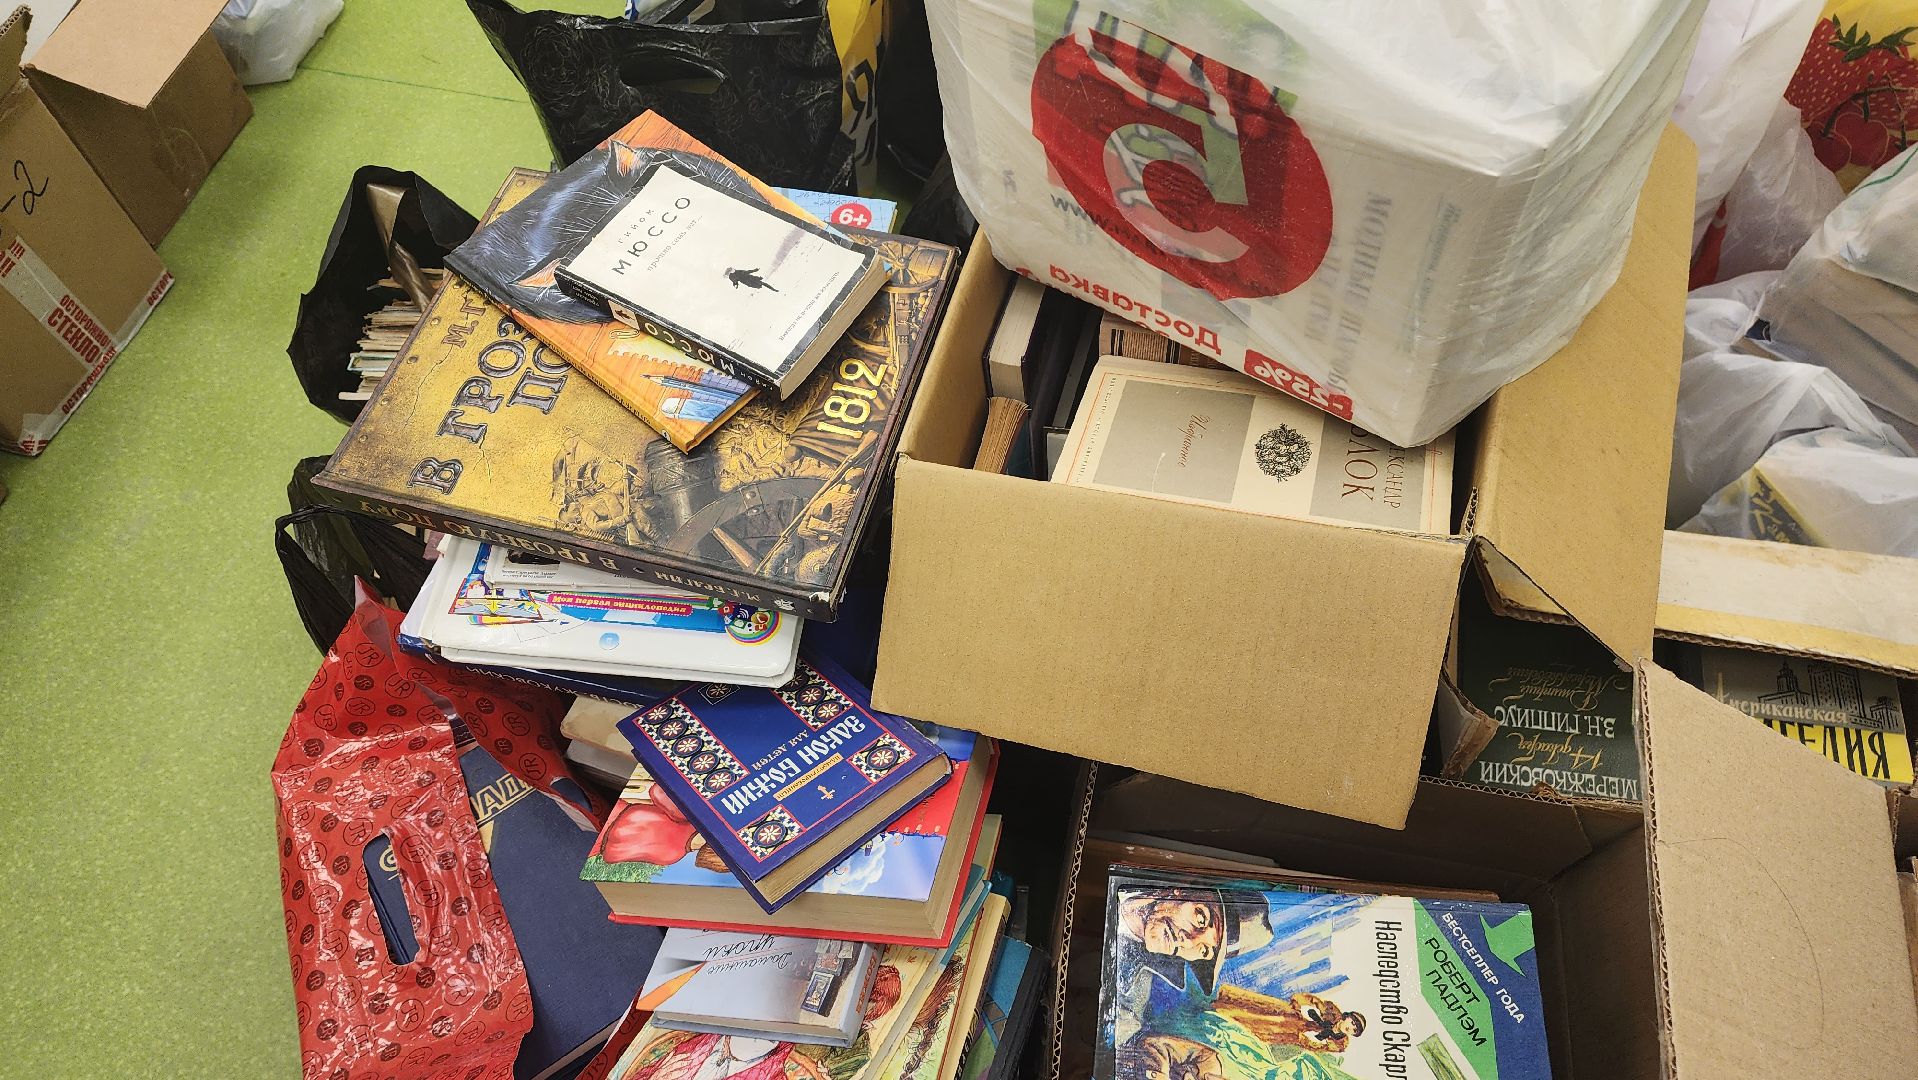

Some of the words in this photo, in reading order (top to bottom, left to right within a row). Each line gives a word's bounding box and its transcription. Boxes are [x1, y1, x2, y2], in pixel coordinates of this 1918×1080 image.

[611, 197, 691, 275] МЮССО
[838, 208, 868, 226] 6+
[644, 321, 736, 376] МЮССО
[816, 357, 889, 439] 1812
[406, 455, 464, 496] В
[359, 500, 439, 529] ПОРУ
[443, 520, 592, 565] ГРОЗНУЮ
[598, 555, 620, 571] В
[575, 597, 611, 608] первая
[613, 600, 687, 613] энциклопедия
[796, 714, 866, 766] ЗАКОН
[1494, 704, 1581, 734] ГИППИУС
[720, 757, 802, 815] БОЖИЙ
[1479, 760, 1638, 800] МЕРЕЖКОВСКИЙ
[1372, 920, 1409, 1025] Наследство
[1425, 936, 1481, 1004] РОБЕРТ
[1441, 912, 1499, 986] БЕСТСЕЛЛЕР
[1495, 987, 1525, 1024] ГОДА
[1425, 968, 1488, 1047] ПАДЛЭМ
